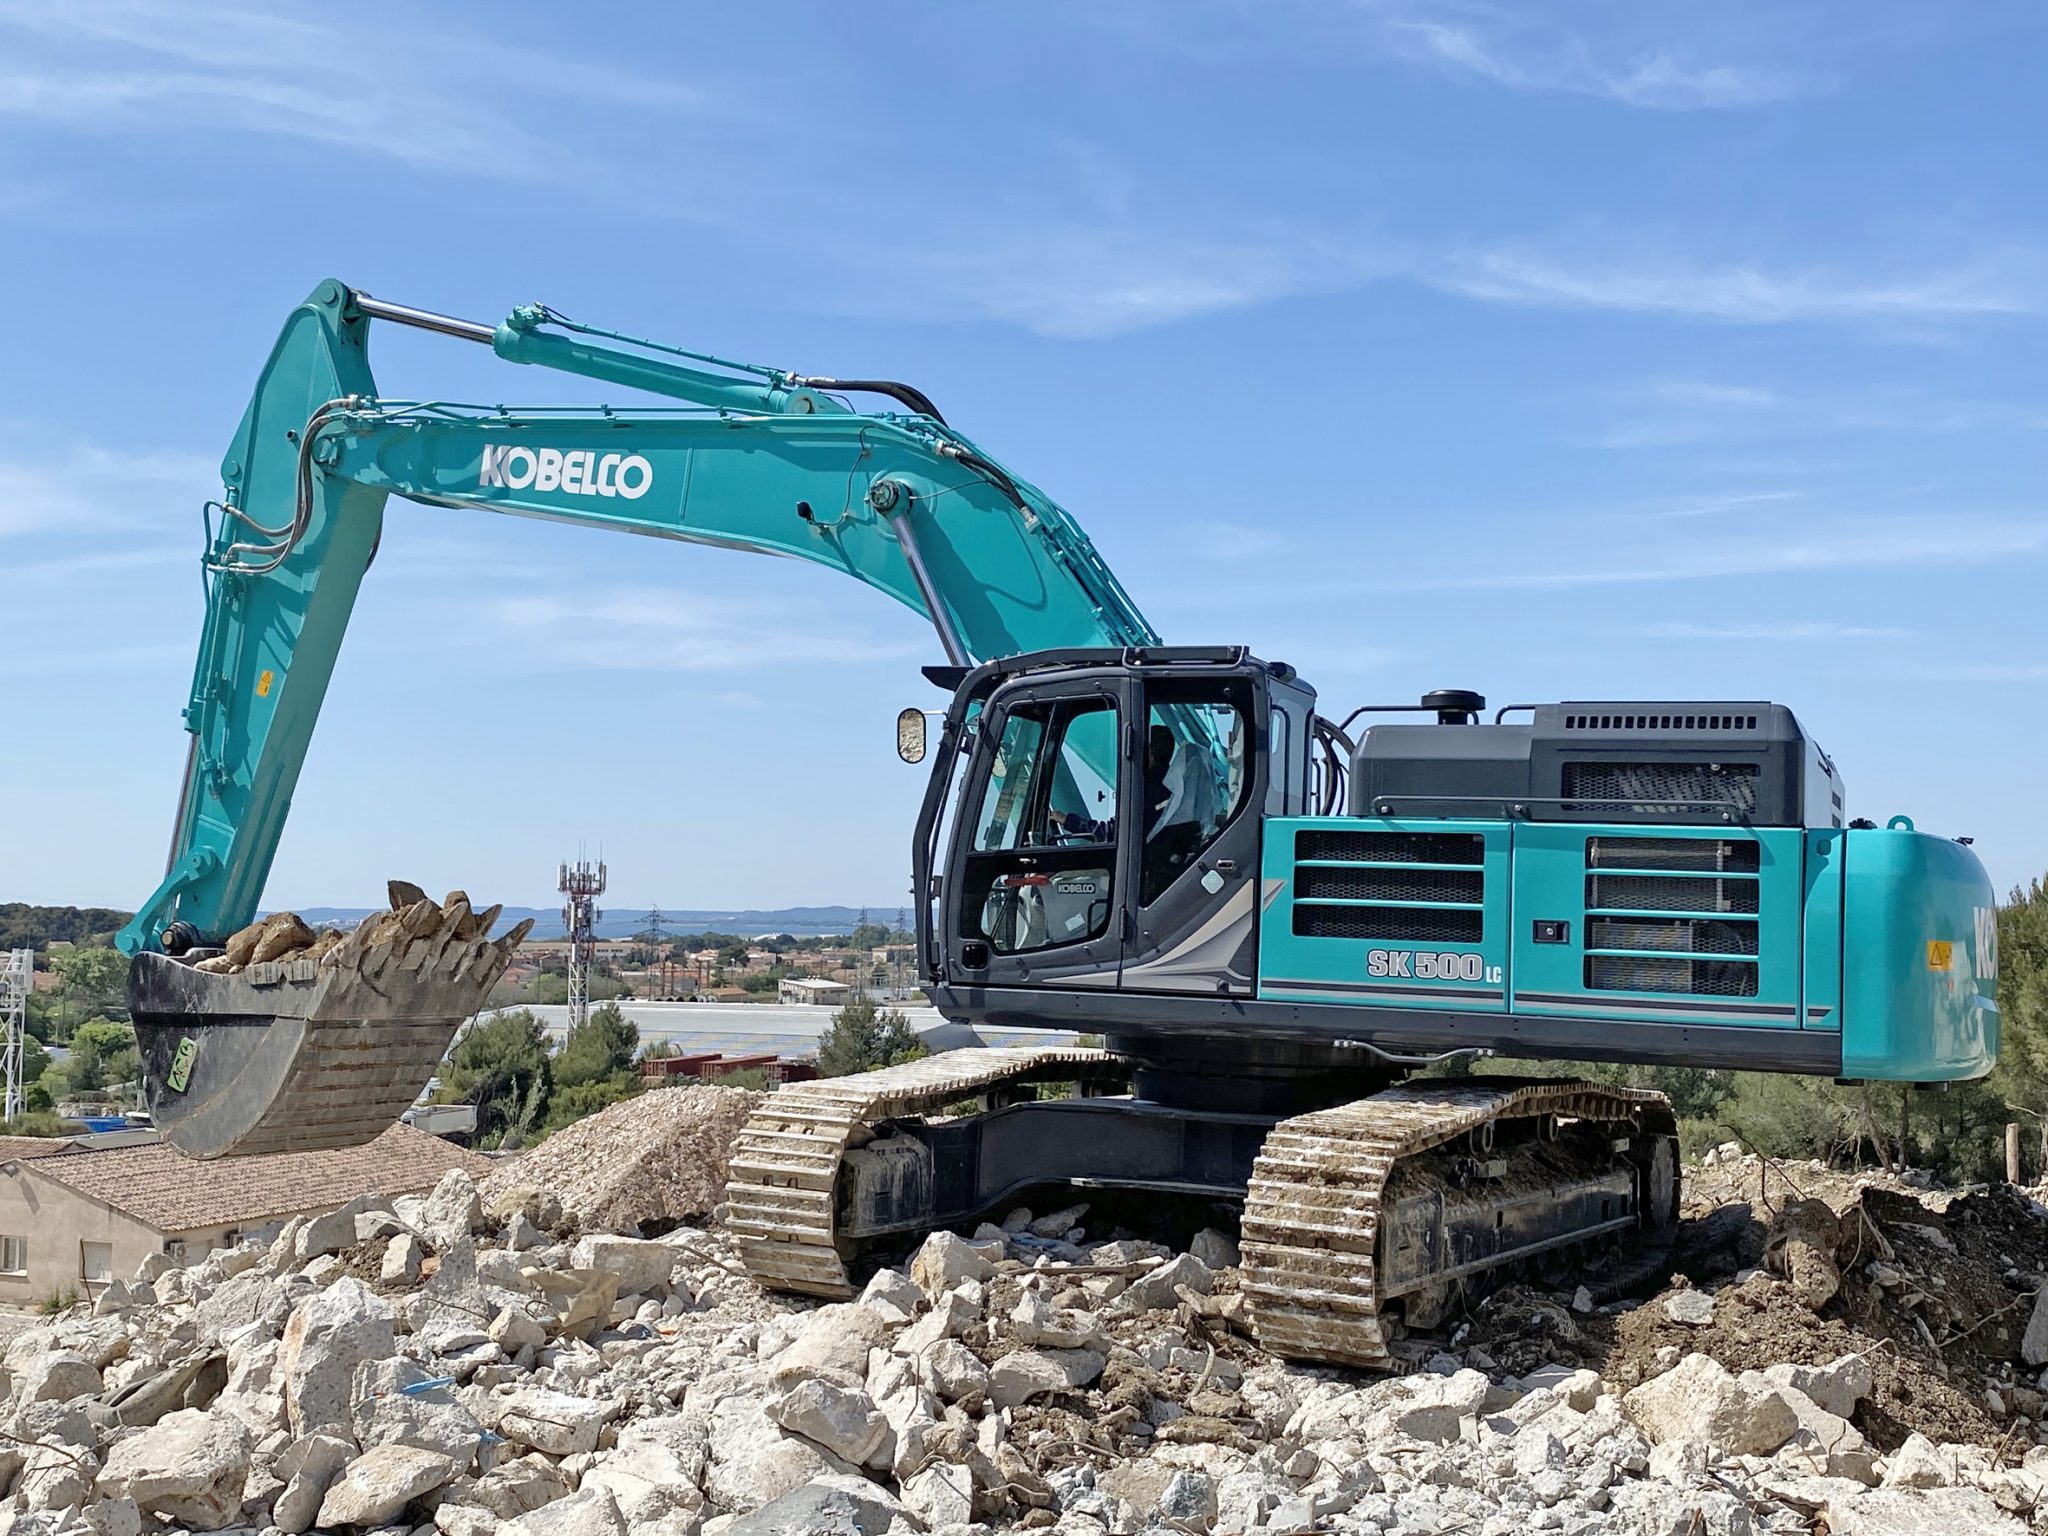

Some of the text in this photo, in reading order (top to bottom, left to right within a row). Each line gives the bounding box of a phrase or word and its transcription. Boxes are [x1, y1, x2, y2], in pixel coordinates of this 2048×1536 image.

[479, 443, 653, 499] KOBELCO
[1057, 883, 1095, 893] KOBELCO
[1974, 907, 1998, 979] KO
